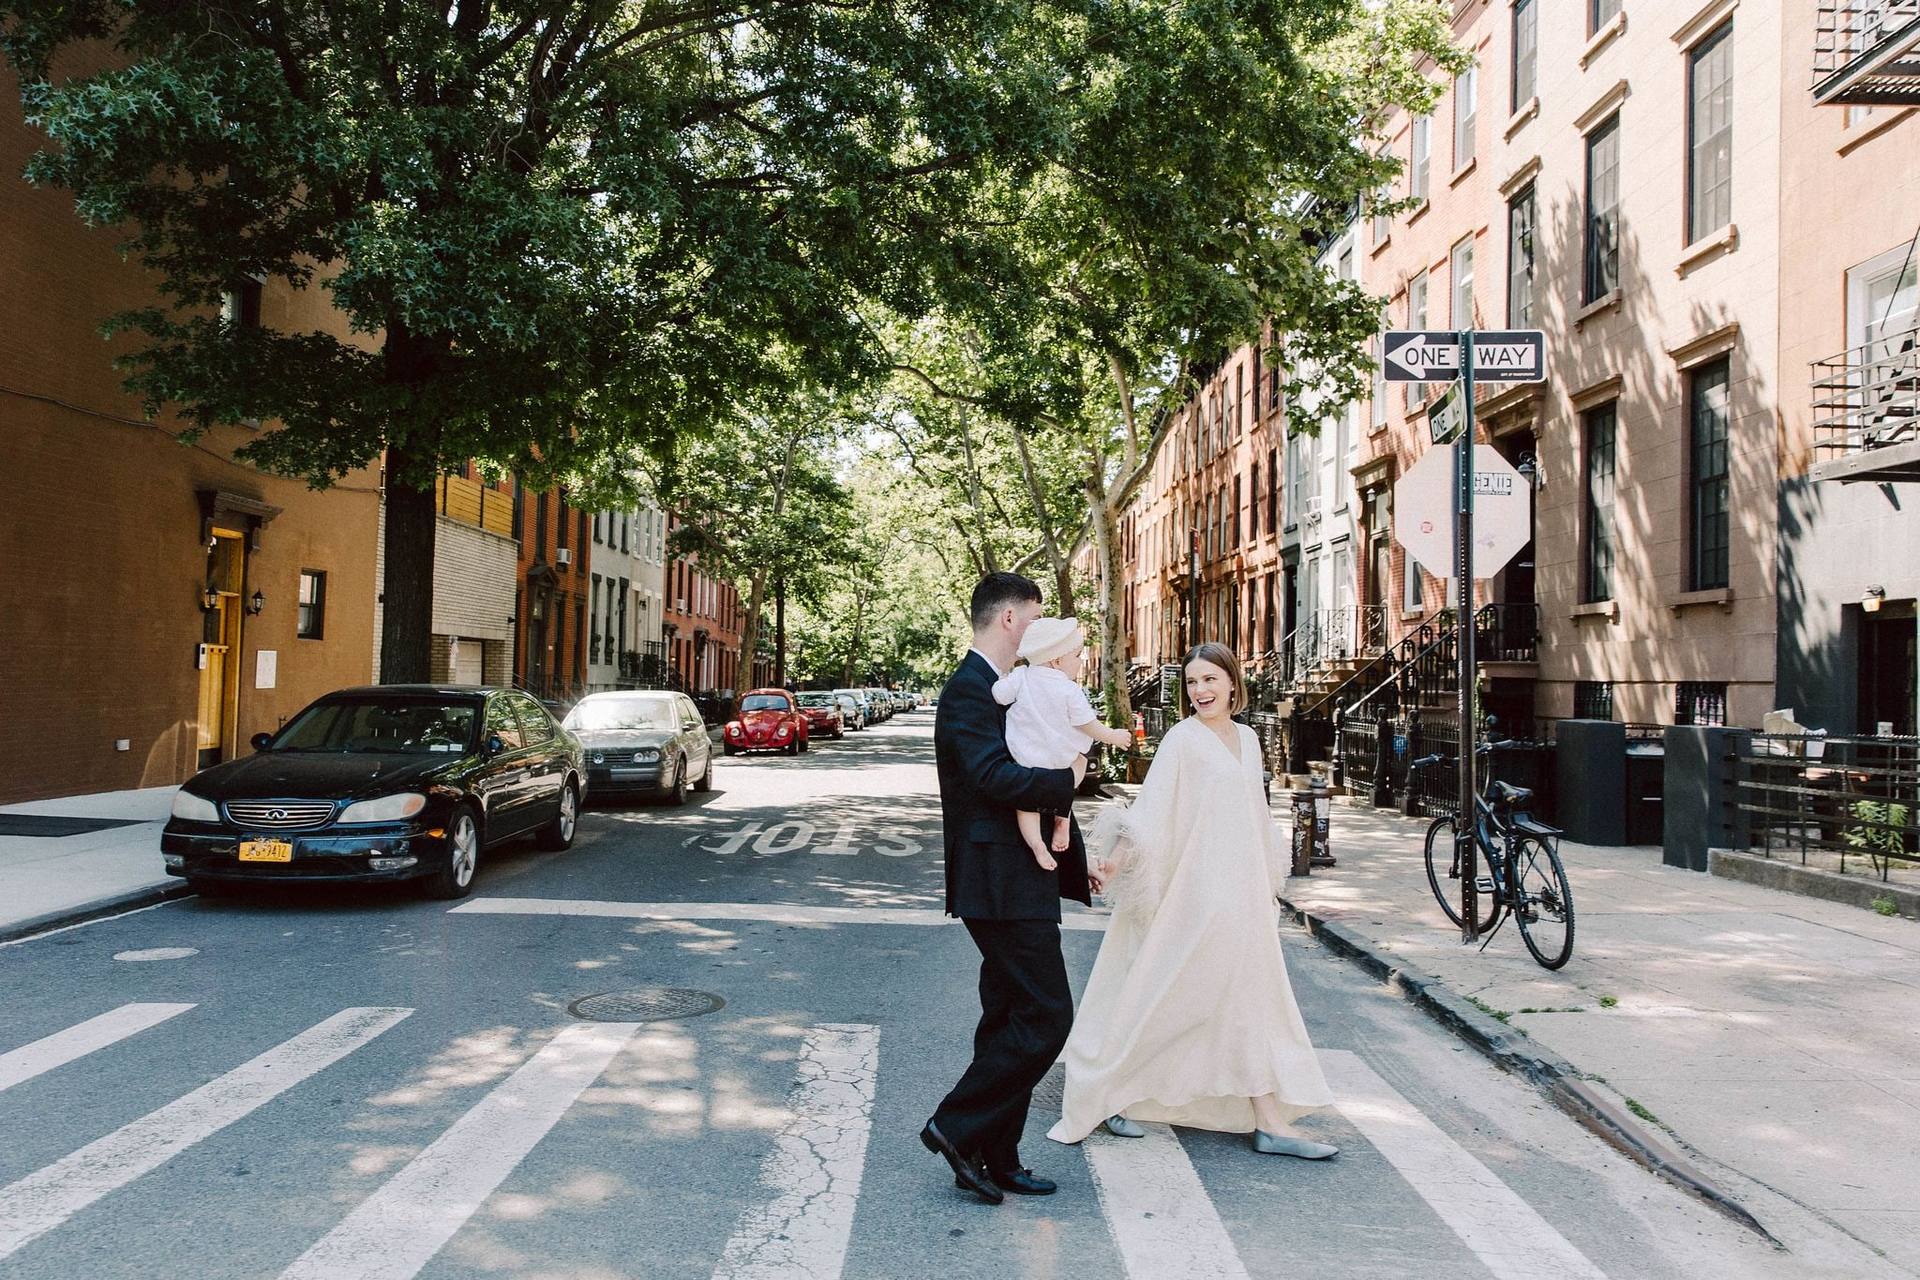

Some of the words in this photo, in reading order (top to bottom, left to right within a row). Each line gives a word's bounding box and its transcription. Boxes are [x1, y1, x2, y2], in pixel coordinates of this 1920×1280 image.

[1405, 347, 1450, 366] ONE
[1478, 347, 1528, 366] WAY
[1432, 411, 1447, 438] ONE
[681, 820, 923, 857] STOP
